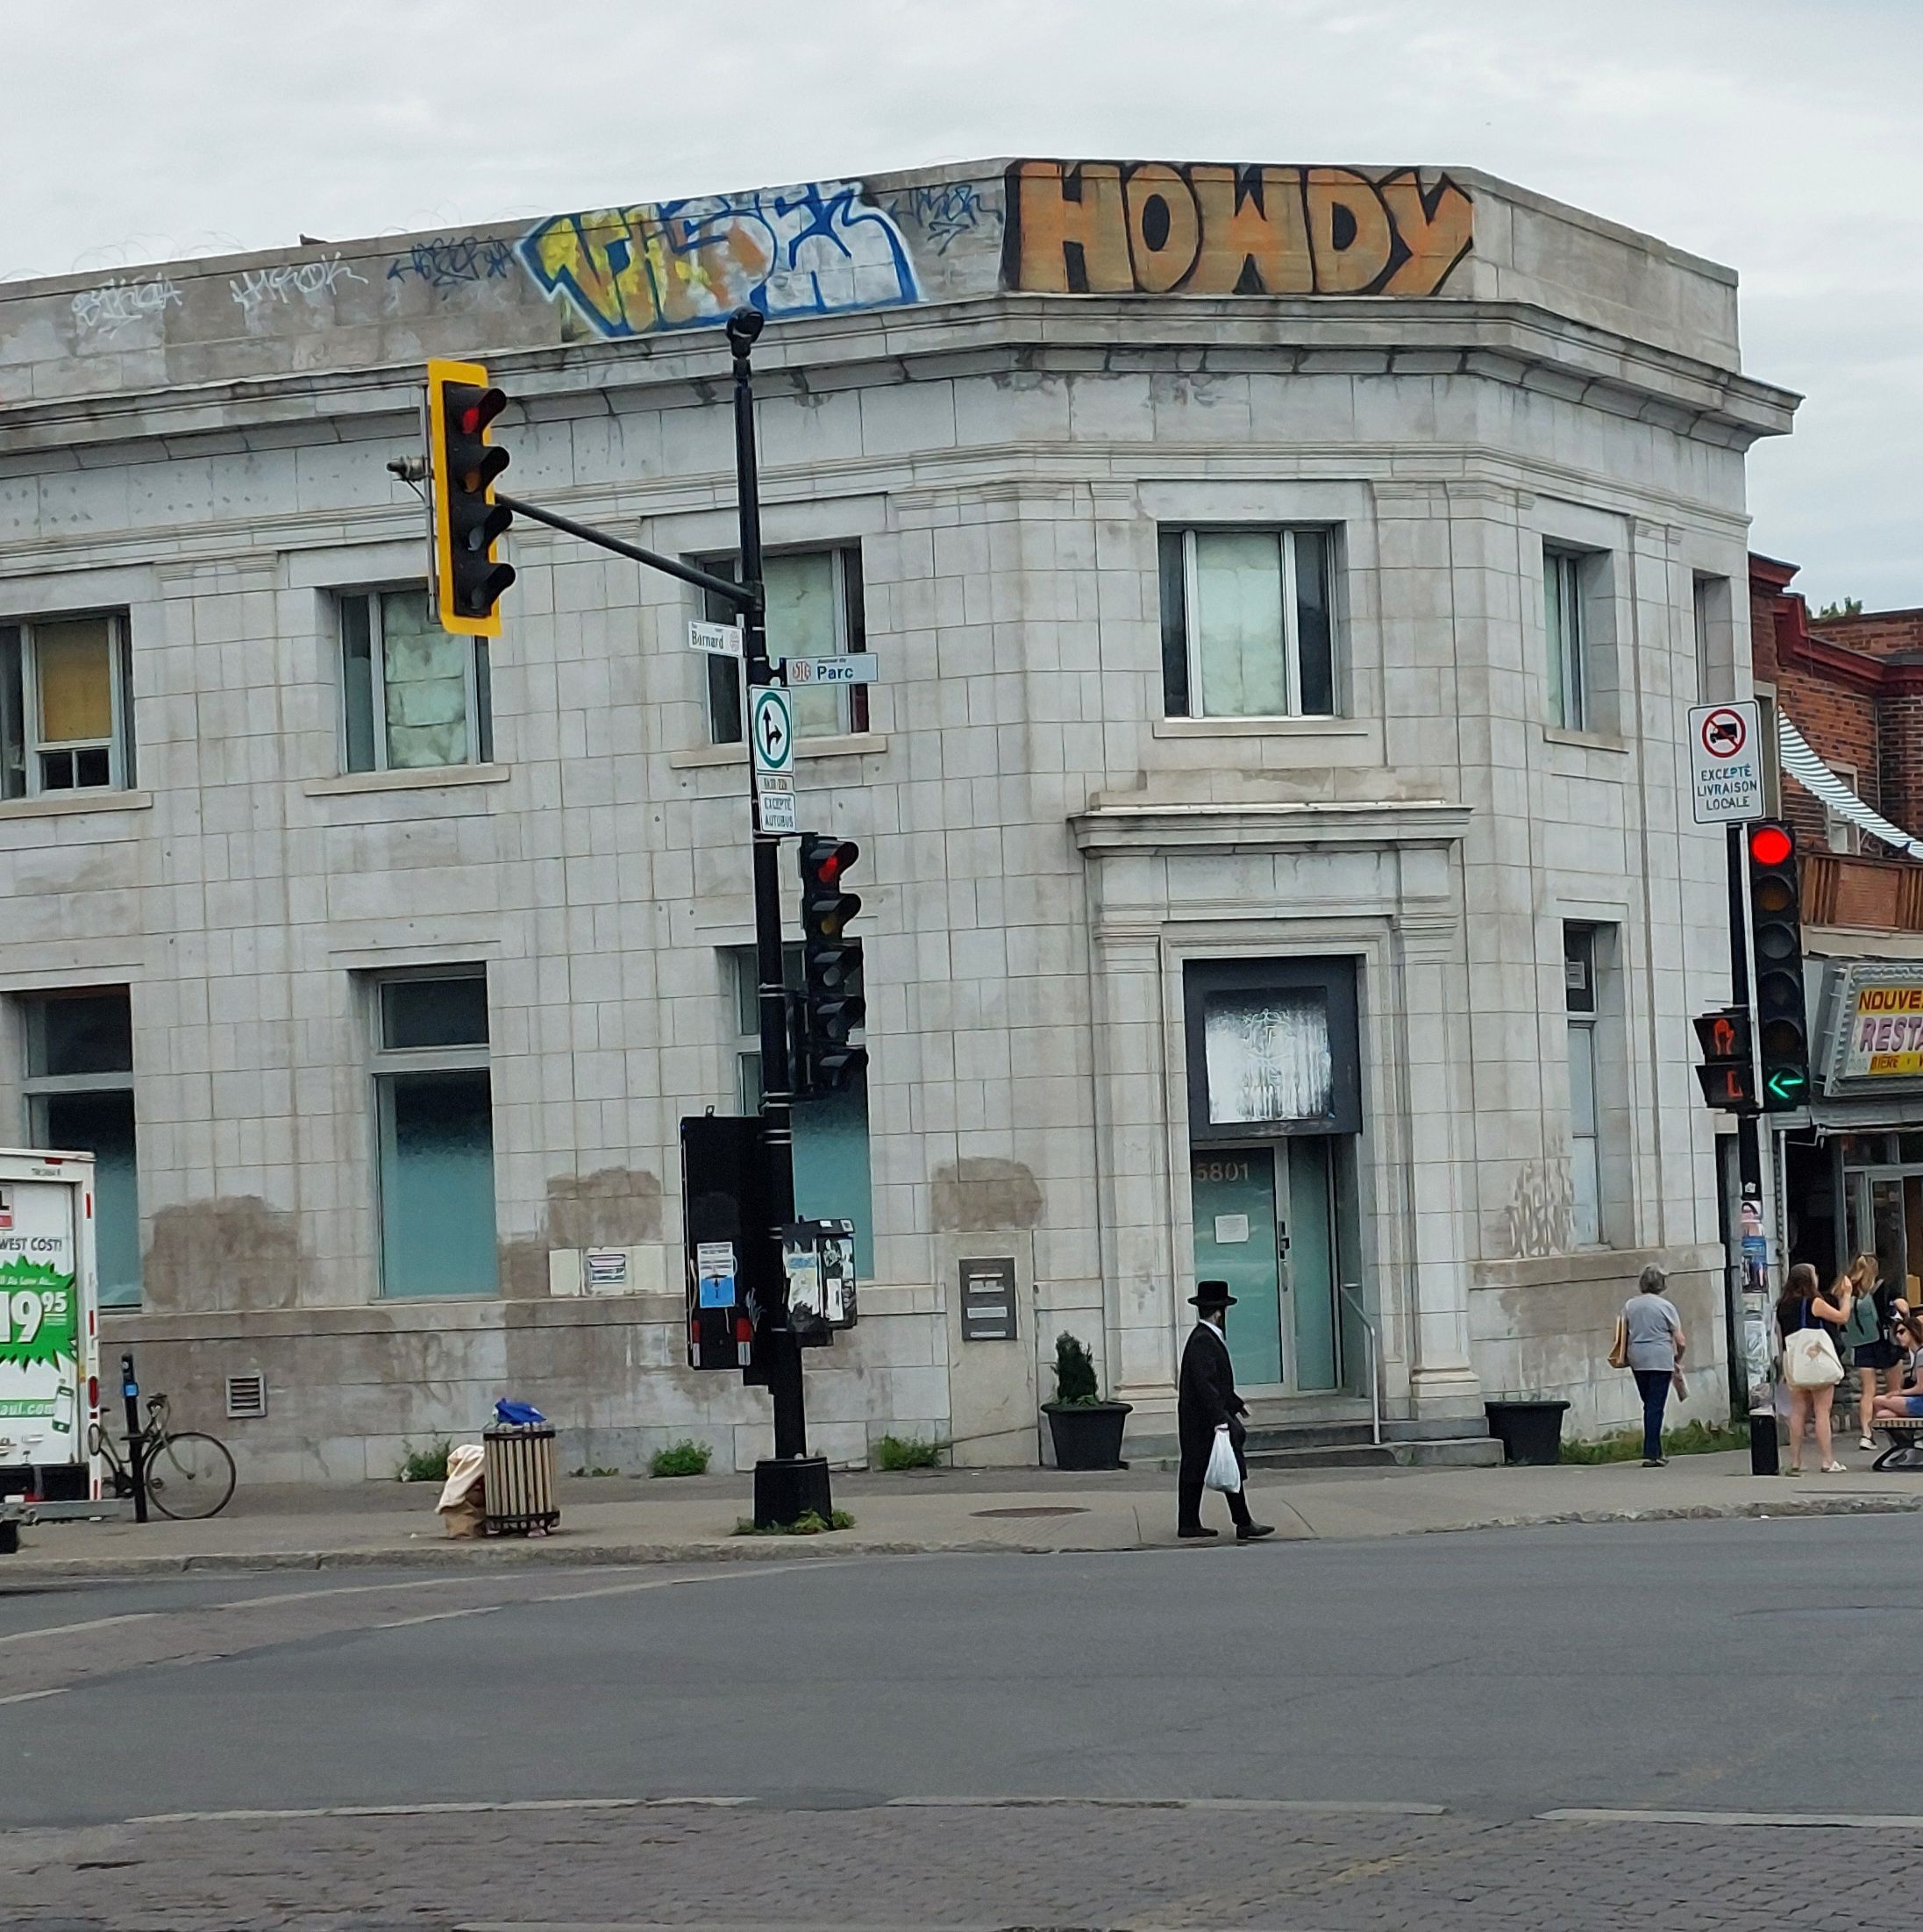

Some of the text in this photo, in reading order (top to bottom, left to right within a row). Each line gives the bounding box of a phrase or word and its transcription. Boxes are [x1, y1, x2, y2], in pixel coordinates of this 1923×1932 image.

[1002, 159, 1473, 298] HOWDY
[816, 665, 854, 681] Parc
[1697, 780, 1758, 797] LIVRAISON
[1706, 795, 1751, 811] LOCALE
[1859, 990, 1923, 1010] NOUVE
[1194, 1161, 1250, 1182] 5801
